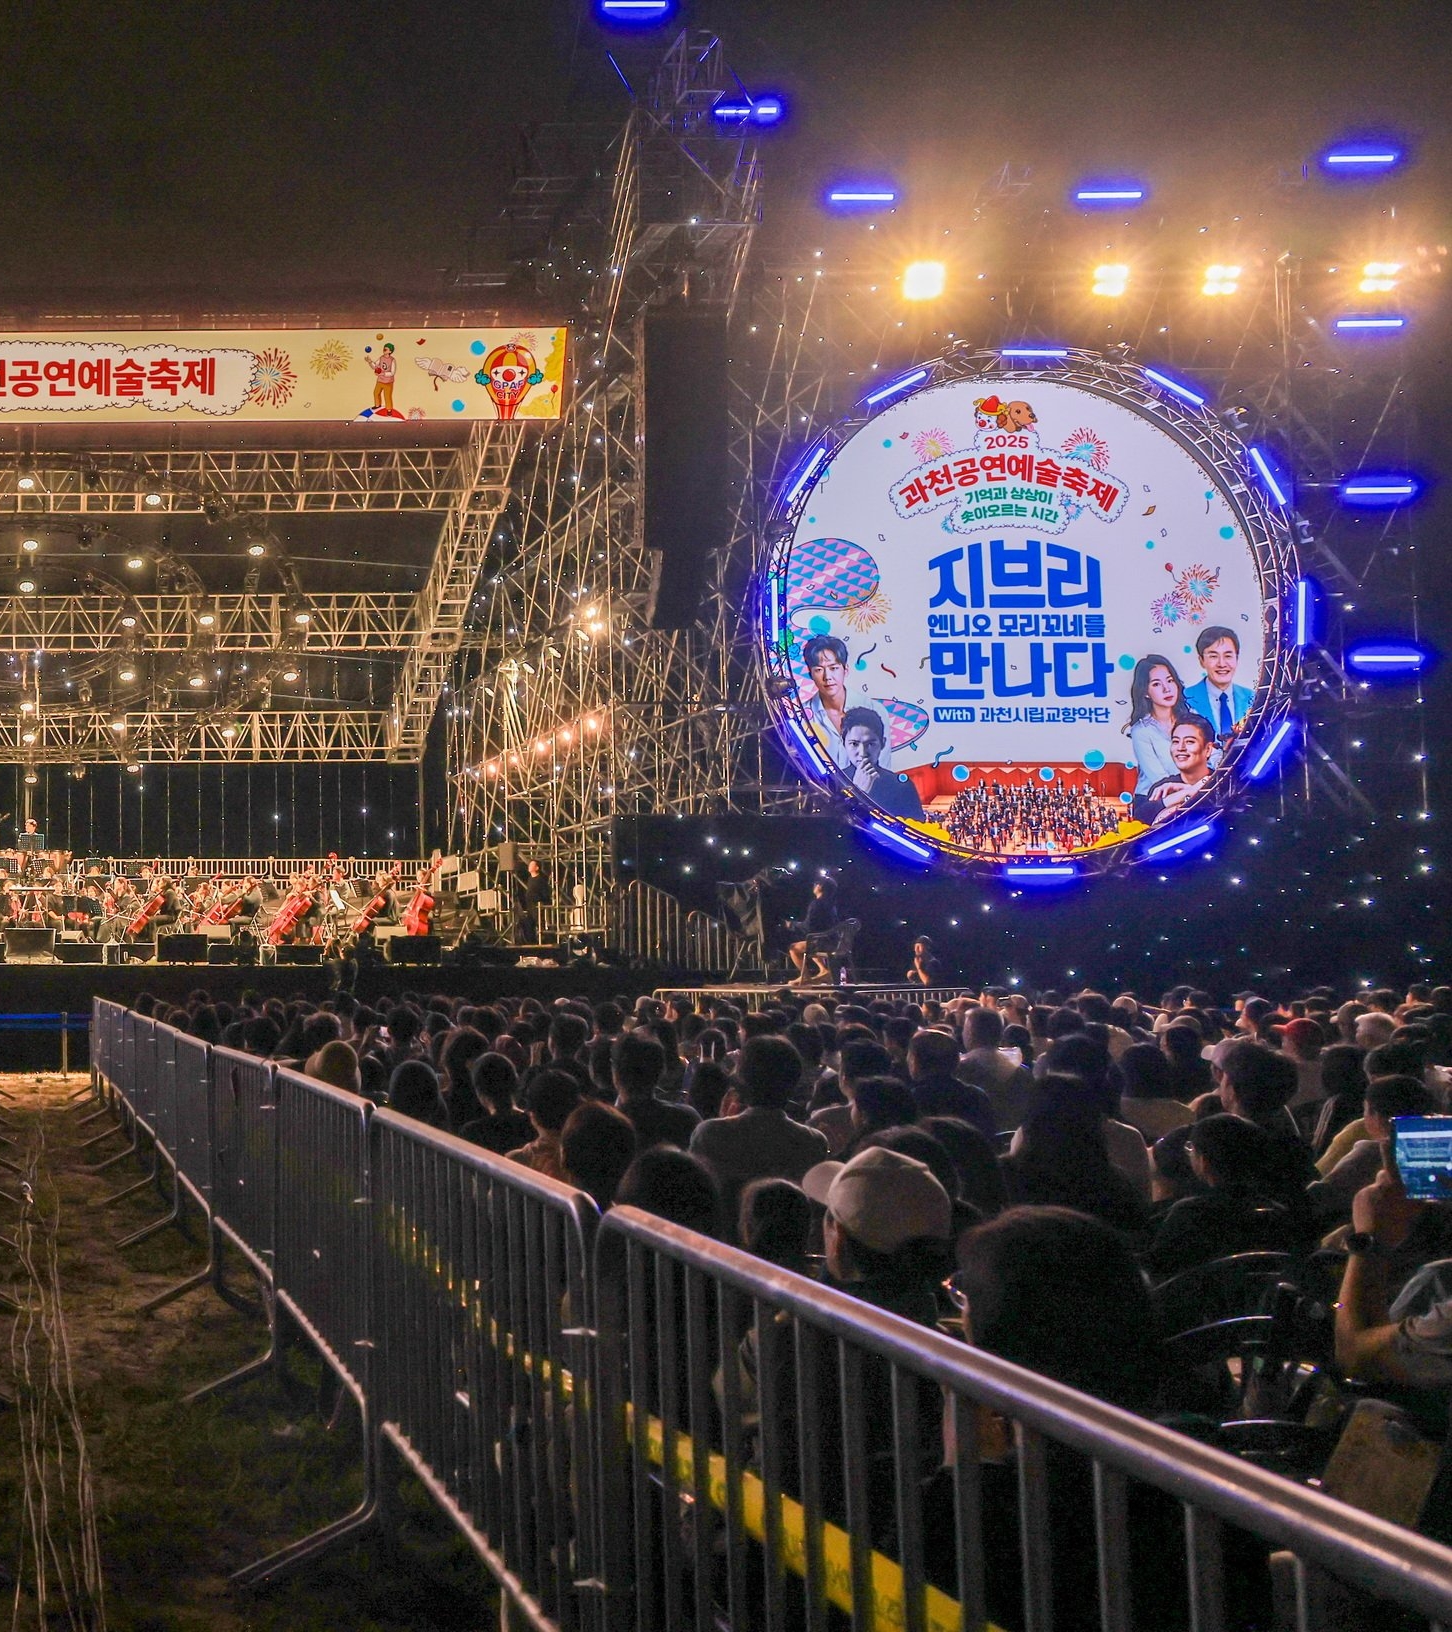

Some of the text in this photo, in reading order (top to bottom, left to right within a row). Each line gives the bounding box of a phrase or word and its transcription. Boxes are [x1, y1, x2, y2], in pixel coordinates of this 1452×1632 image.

[493, 380, 524, 389] GPAF
[497, 391, 519, 399] CITY
[984, 434, 1029, 450] 2025
[898, 453, 1120, 512] 과천공연예술축제
[964, 487, 1053, 505] 기억과 상상이
[960, 504, 1059, 524] 솟아오르는 시간
[928, 540, 1102, 608] 지브리
[927, 614, 1105, 638] 엔니오 모리꼬네를
[929, 642, 1114, 699] 만나다
[937, 707, 1110, 723] With 과천시립교향악단
